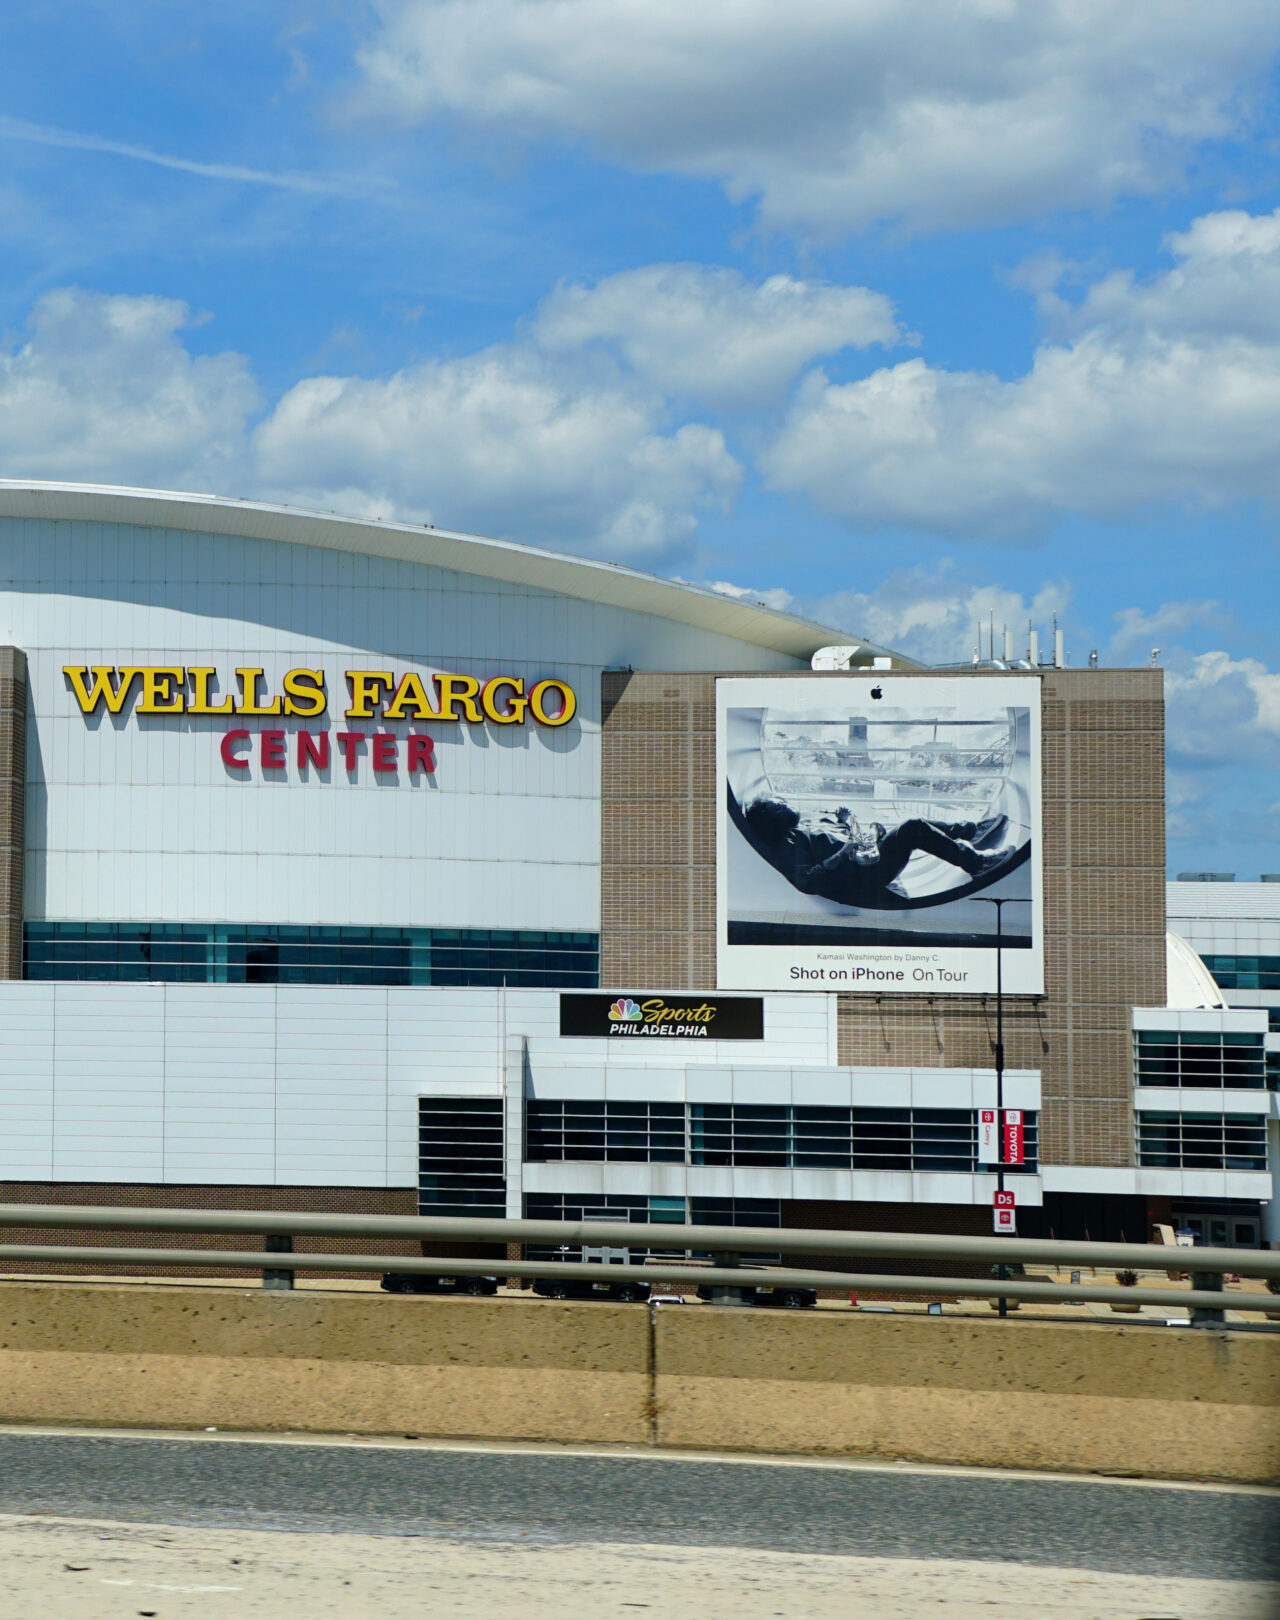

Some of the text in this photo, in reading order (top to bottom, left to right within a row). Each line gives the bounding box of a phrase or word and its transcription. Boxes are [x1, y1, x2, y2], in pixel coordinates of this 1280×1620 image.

[62, 665, 578, 727] WELLS FARGO
[221, 728, 436, 773] CENTER
[817, 953, 845, 961] Kamasi
[847, 953, 892, 962] Washington
[894, 954, 903, 962] by
[905, 954, 930, 962] Danny
[790, 967, 968, 982] Shot on iPhone On Tour
[641, 999, 717, 1025] Sports
[609, 1024, 708, 1036] PHILADELPHIA
[1009, 1126, 1017, 1163] TOYOTA
[997, 1194, 1012, 1205] D5
